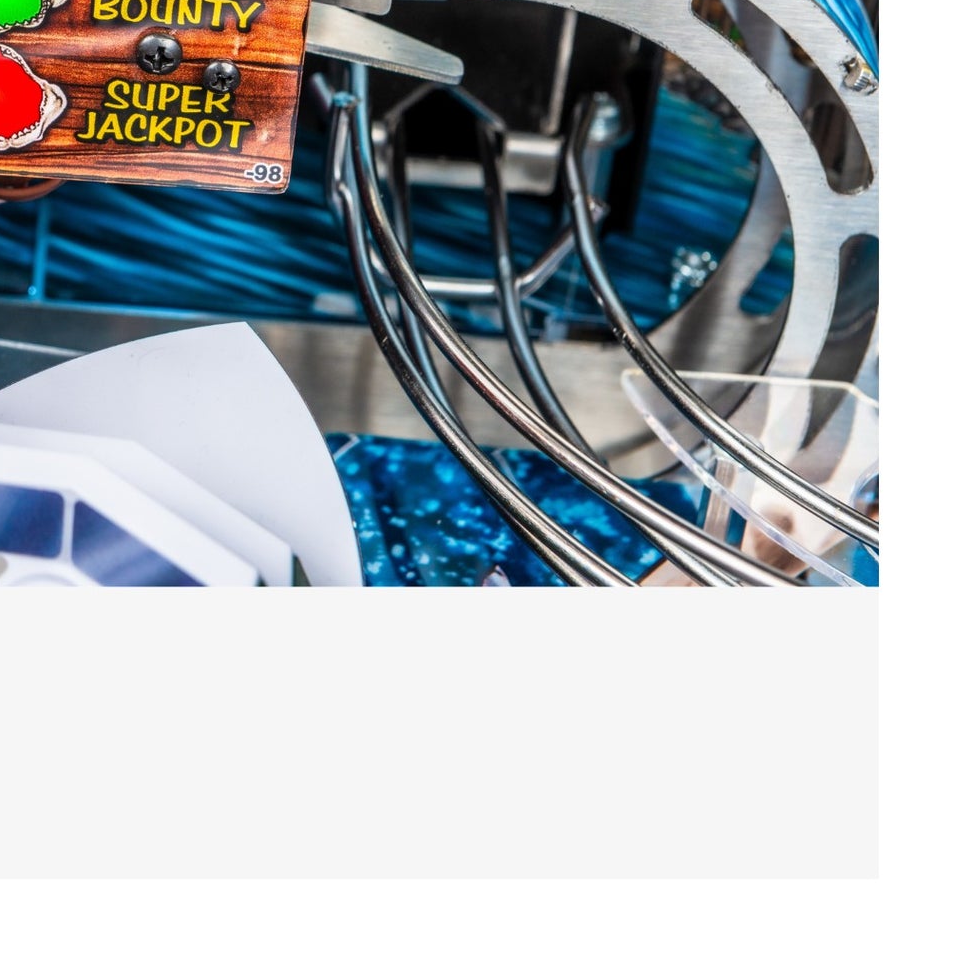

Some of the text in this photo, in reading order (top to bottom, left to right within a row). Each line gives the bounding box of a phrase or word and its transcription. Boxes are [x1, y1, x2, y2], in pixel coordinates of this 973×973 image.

[104, 80, 230, 114] SUPER
[77, 112, 251, 148] JACKPOT
[245, 164, 282, 183] -98
